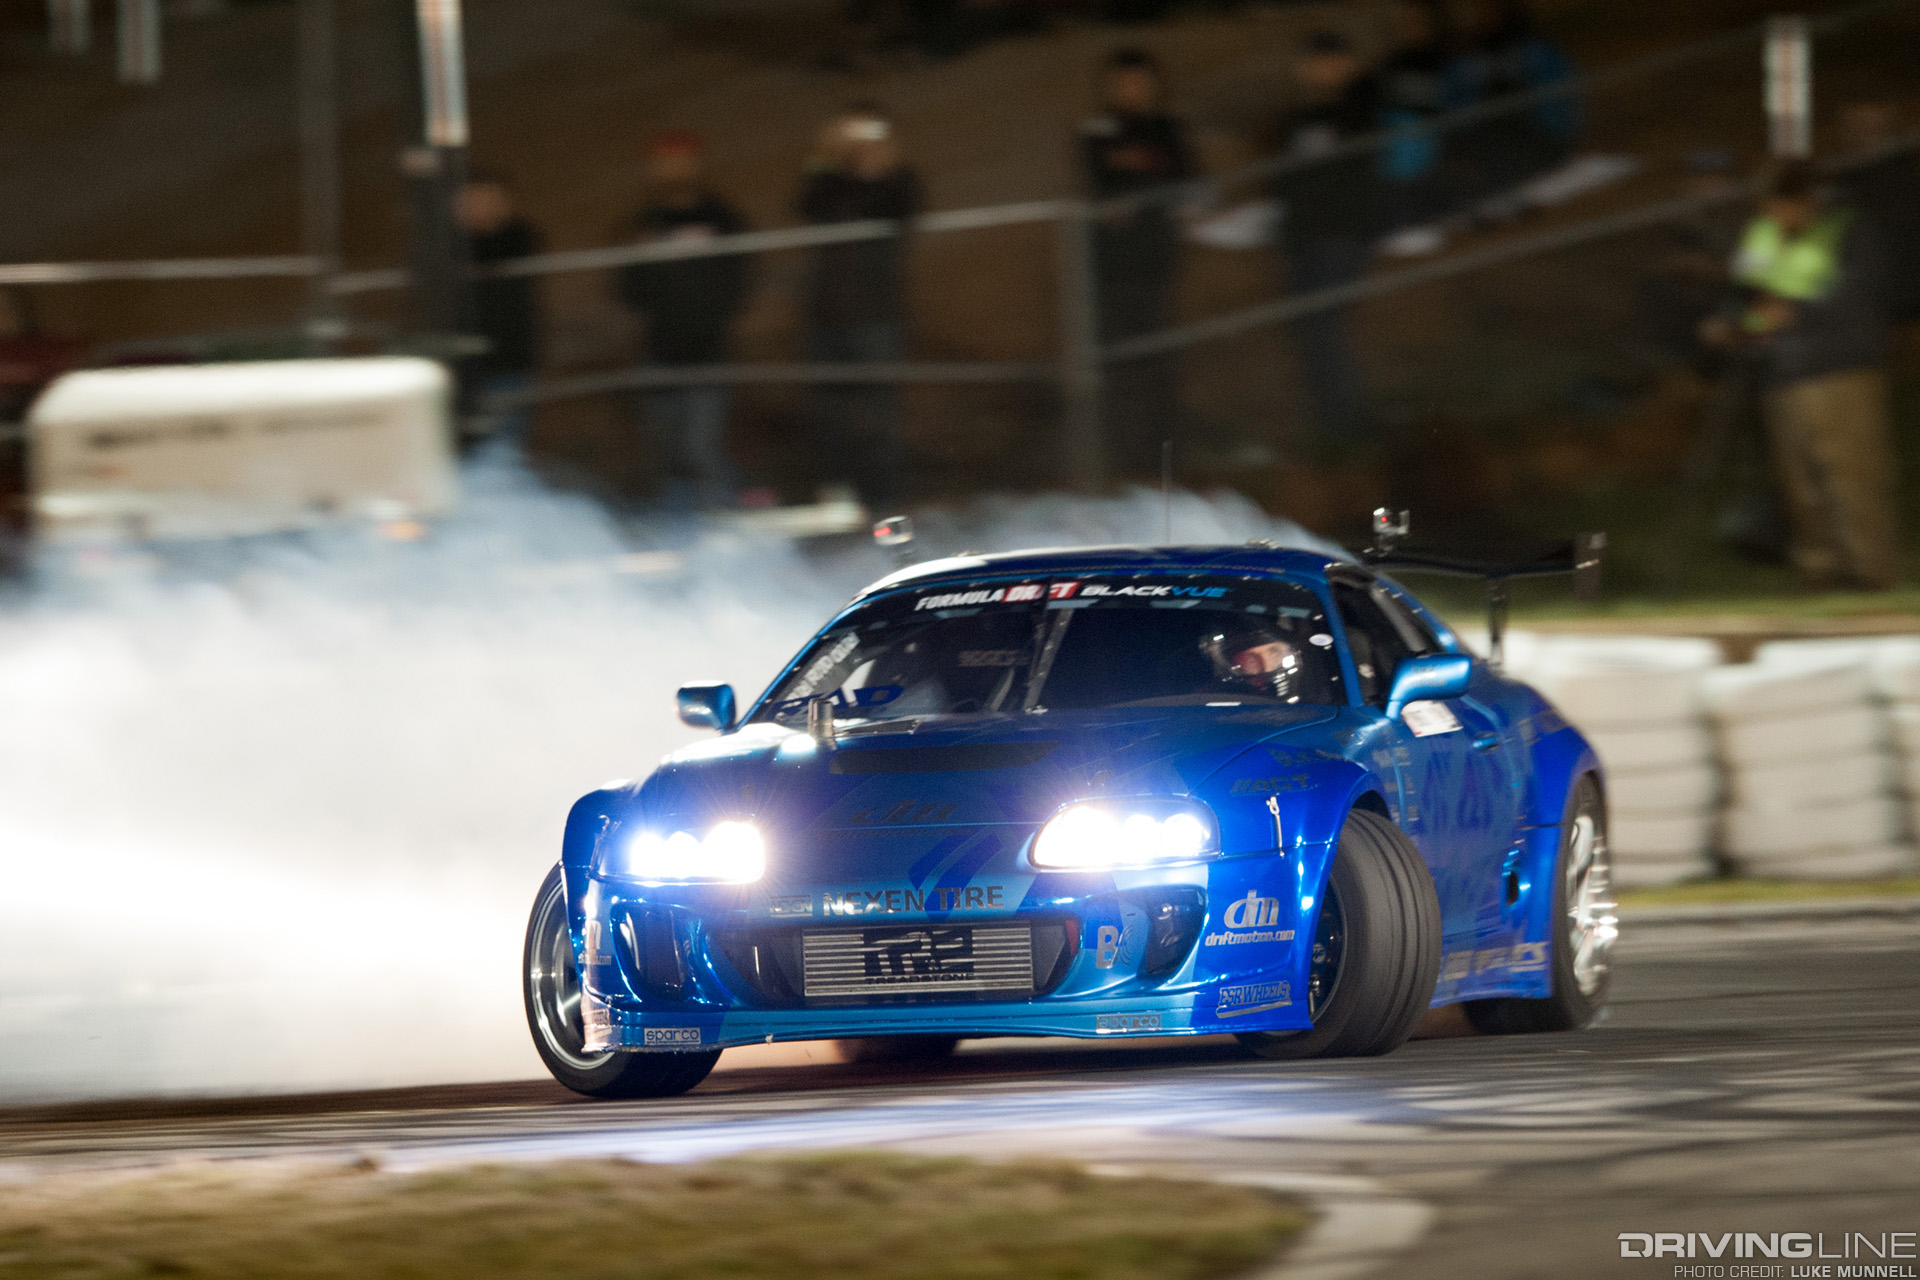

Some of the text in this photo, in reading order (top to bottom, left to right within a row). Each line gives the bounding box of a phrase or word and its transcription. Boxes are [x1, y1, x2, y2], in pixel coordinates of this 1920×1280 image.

[914, 581, 1080, 611] FORMULA DRFT
[1080, 585, 1229, 598] BLACKVUE
[823, 886, 1005, 916] NEXEN TIRE
[1224, 890, 1279, 929] dm
[1205, 930, 1295, 947] driftmotion.com
[1098, 1015, 1160, 1030] sparco
[645, 1028, 700, 1044] sparco
